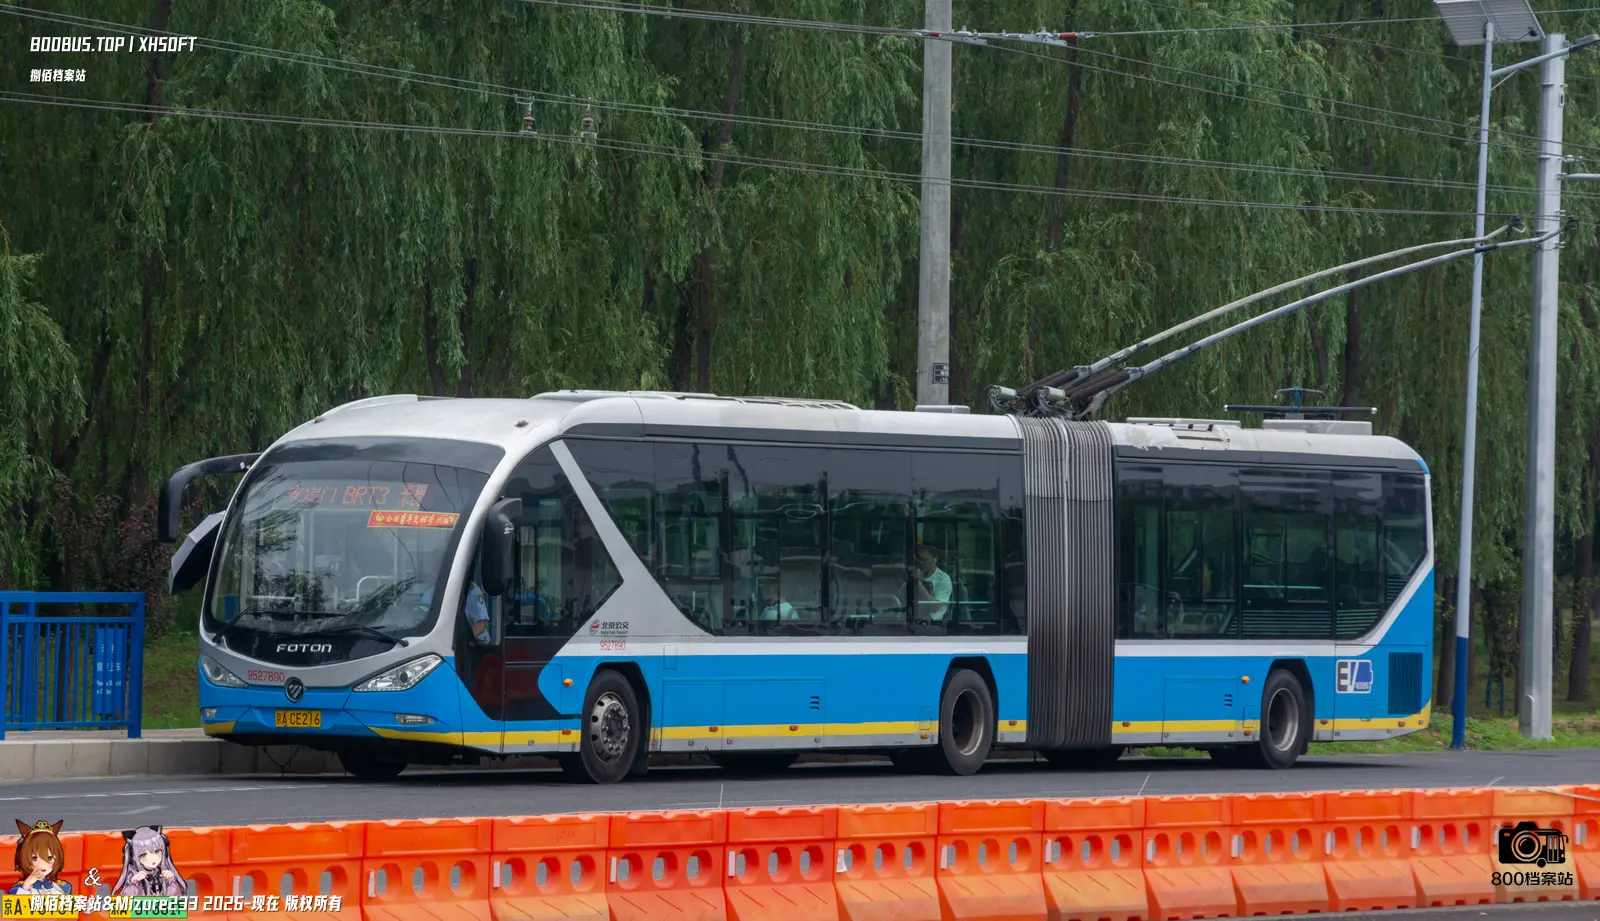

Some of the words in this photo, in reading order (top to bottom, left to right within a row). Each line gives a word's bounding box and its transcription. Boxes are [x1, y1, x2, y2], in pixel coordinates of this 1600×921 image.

[342, 485, 391, 505] BRT3
[602, 621, 629, 629] 北京公交
[276, 644, 332, 653] FOTON
[247, 669, 285, 683] 9527890
